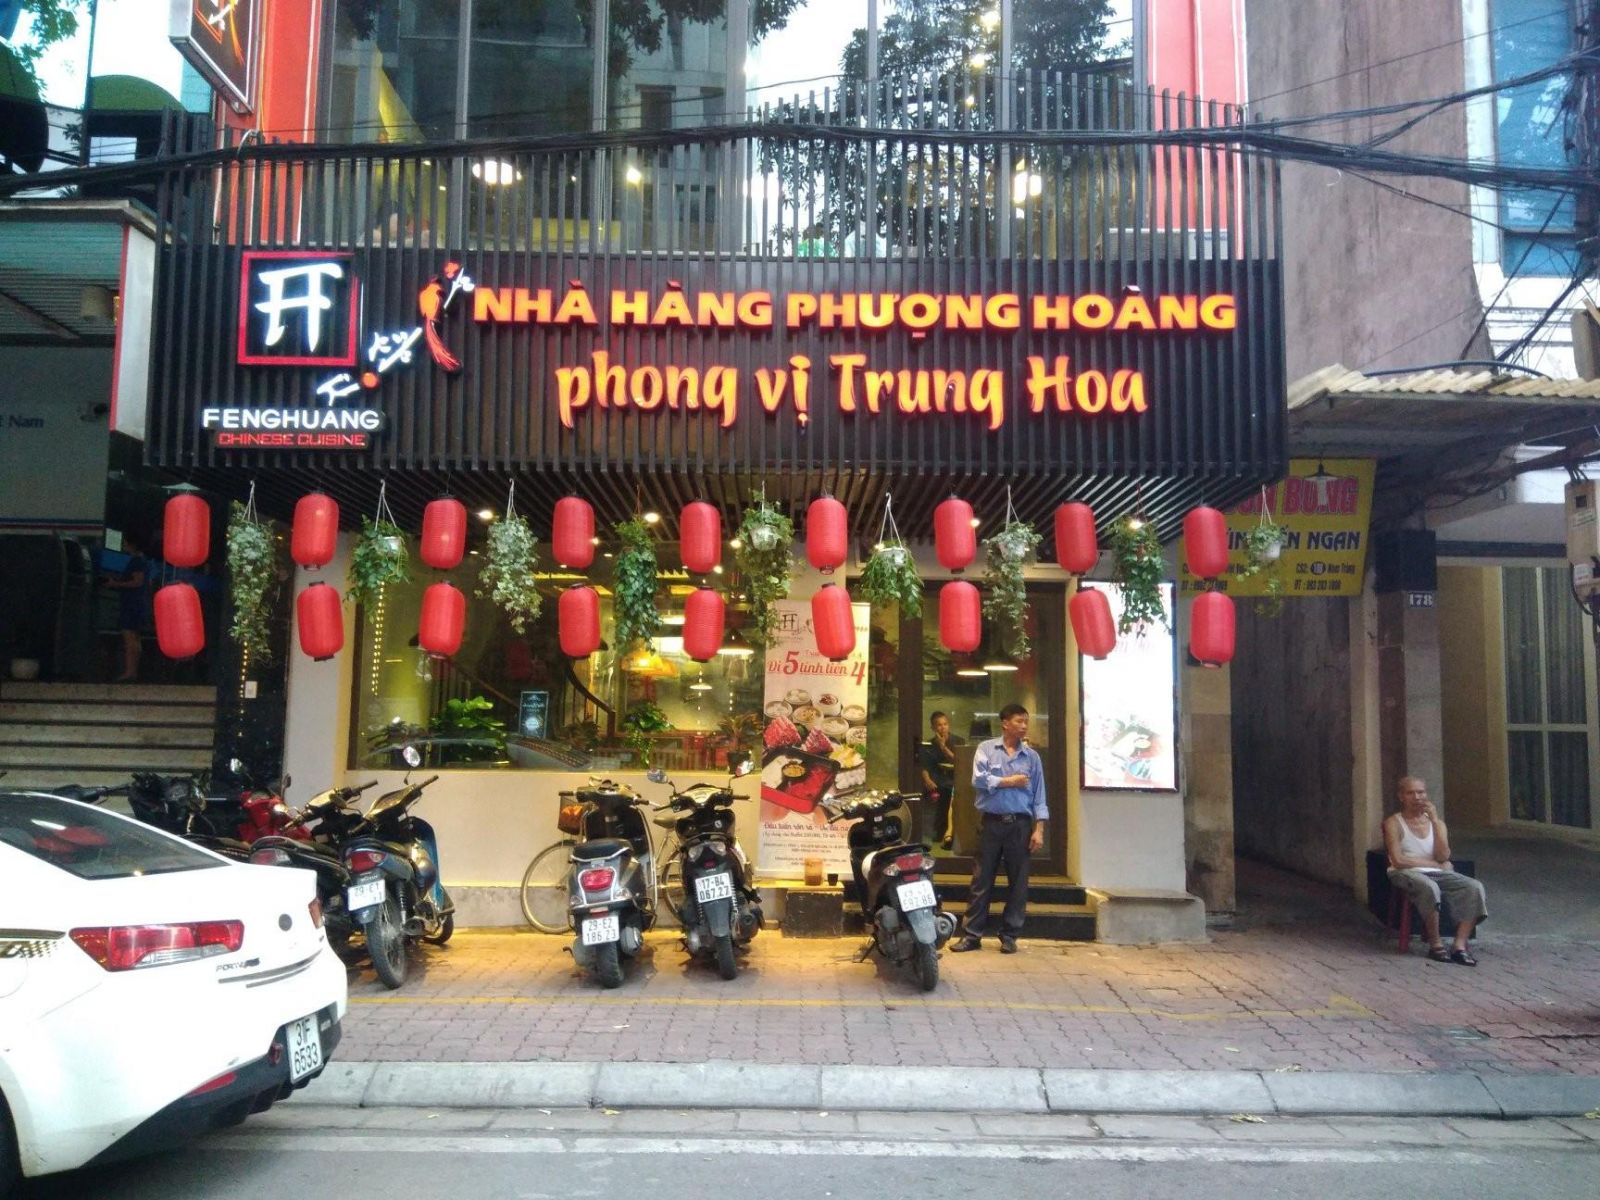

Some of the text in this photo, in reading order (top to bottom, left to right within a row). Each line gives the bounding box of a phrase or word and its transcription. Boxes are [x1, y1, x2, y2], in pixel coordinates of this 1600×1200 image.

[473, 279, 1238, 340] NHÀ HÀNG PHƯỢNG HOÀNG
[554, 349, 1149, 431] phong vị Trung Hoa
[202, 407, 381, 430] FENGHUANG
[218, 432, 367, 447] CHINESE CUISINE
[1307, 531, 1361, 552] NGAN
[1409, 593, 1433, 607] 178
[783, 651, 799, 675] 5
[851, 661, 866, 686] 4
[294, 1042, 318, 1075] 6533
